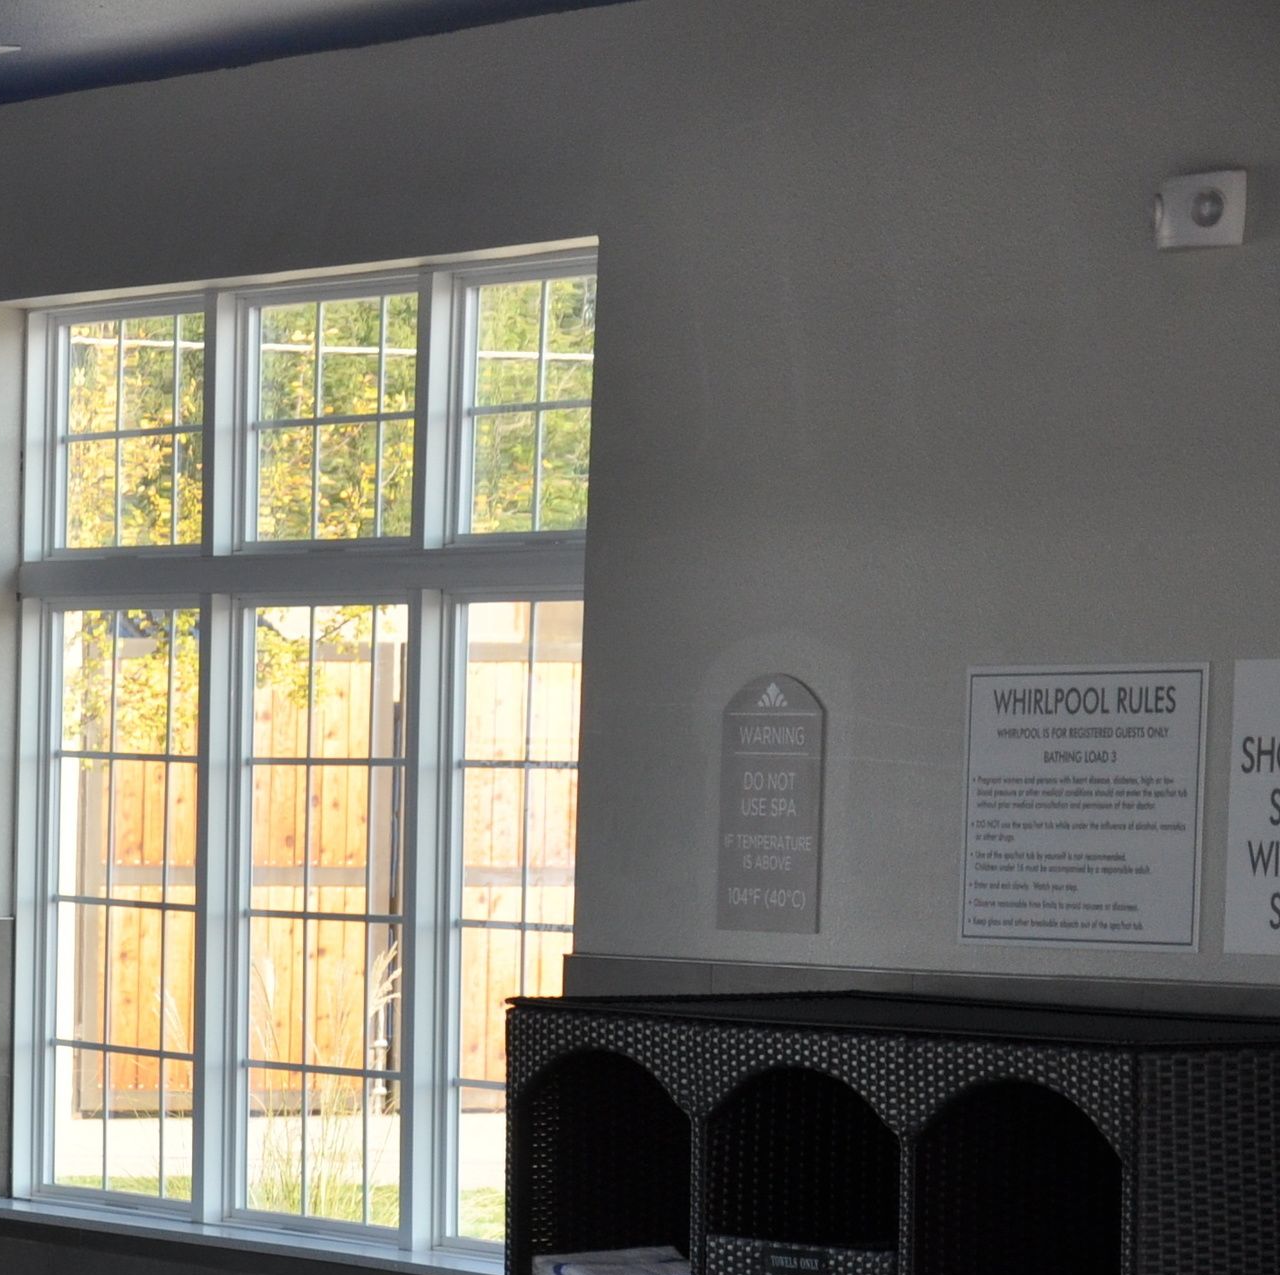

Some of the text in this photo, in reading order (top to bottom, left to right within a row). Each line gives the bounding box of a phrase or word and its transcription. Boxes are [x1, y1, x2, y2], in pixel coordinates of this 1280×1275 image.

[993, 686, 1177, 715] WHIRLPOOL RULES
[739, 726, 805, 745] WARNING
[997, 726, 1169, 739] WHIRLPOOL IS FOR REGISTERED GUESTS ONLY
[1043, 751, 1117, 763] BATHING LOAD 3
[1241, 736, 1280, 773] SH
[743, 772, 796, 791] DO NOT
[741, 798, 797, 817] USE SPA
[724, 834, 813, 852] IF TEMPERATURE
[743, 854, 792, 871] IS ABOVE
[727, 887, 807, 910] 104°F (40°C)
[770, 1255, 819, 1270] TOWELS ONLY
